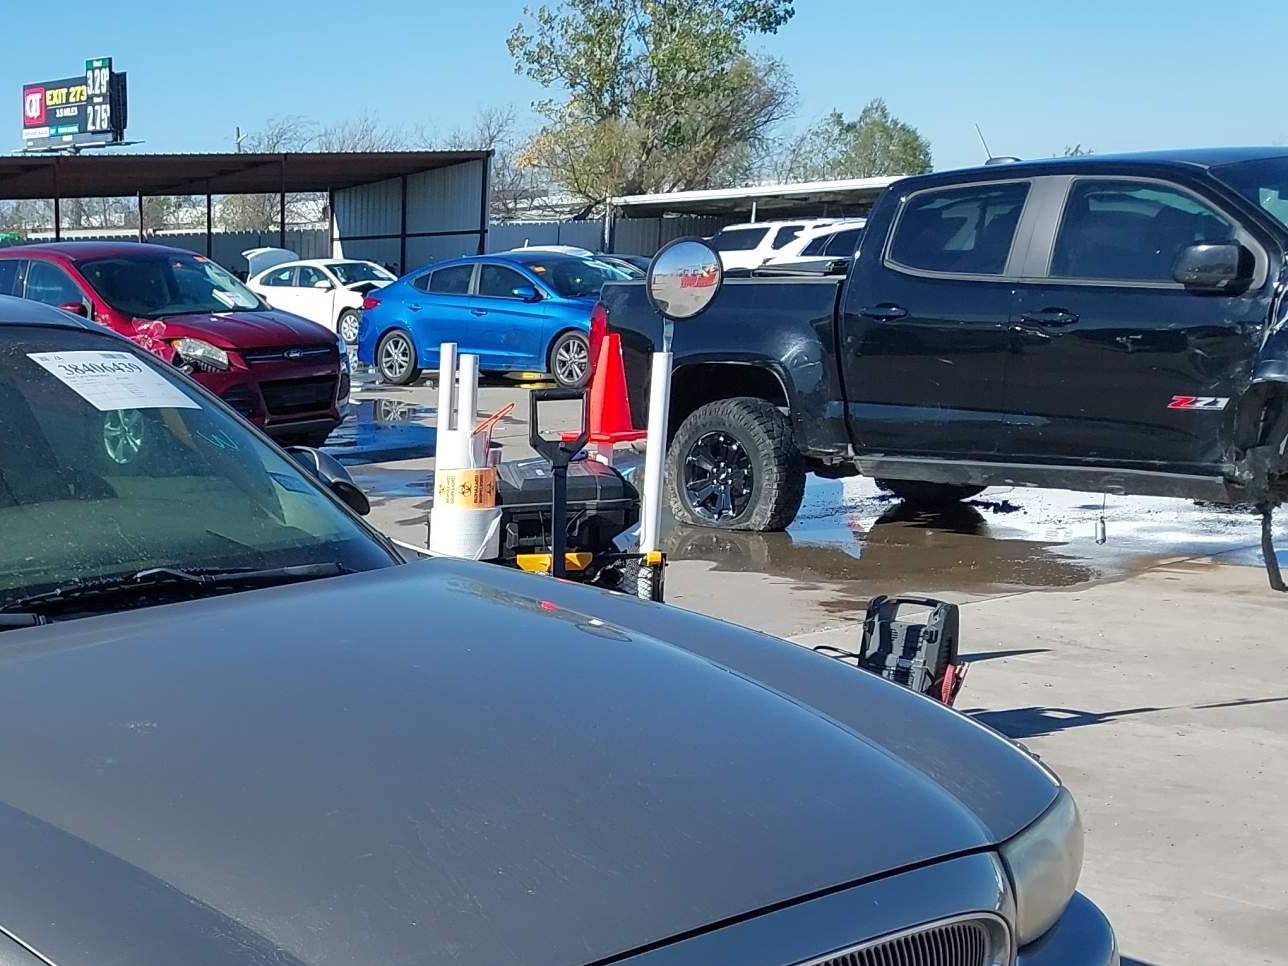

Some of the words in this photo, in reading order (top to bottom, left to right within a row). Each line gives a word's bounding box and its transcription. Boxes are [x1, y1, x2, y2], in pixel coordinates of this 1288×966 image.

[46, 88, 67, 105] EXIT
[69, 85, 87, 102] 273
[25, 93, 42, 120] QT
[58, 362, 143, 375] 38406439
[1167, 395, 1230, 410] Z71
